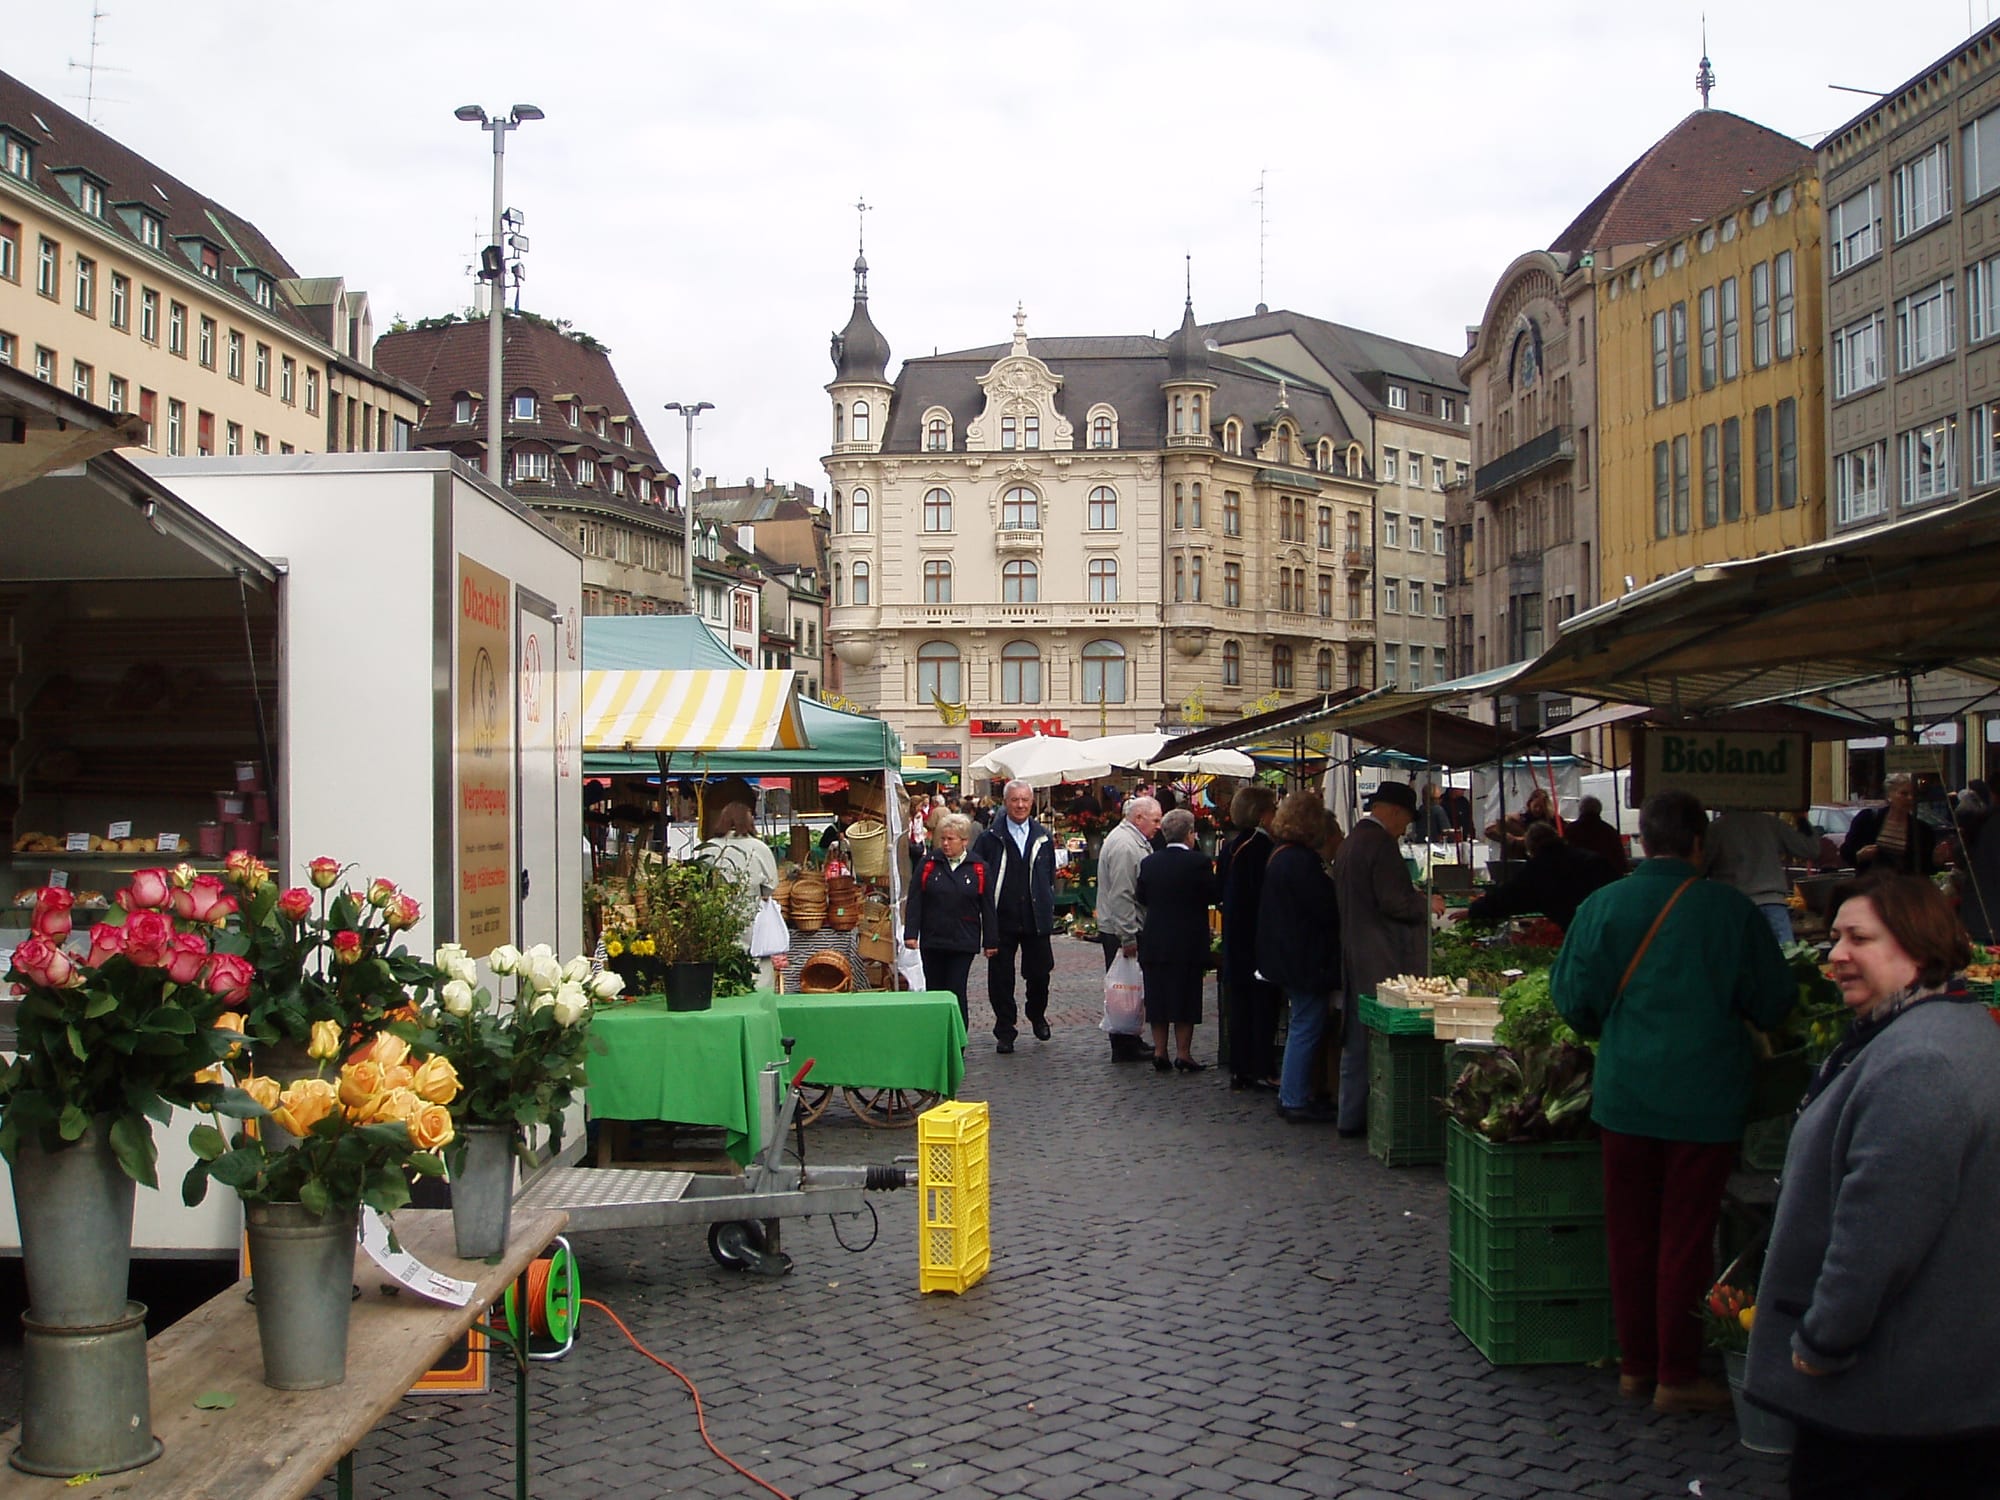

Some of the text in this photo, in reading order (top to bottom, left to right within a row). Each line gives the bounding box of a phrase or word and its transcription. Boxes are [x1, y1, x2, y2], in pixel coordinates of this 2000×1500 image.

[463, 576, 500, 630] Obacht
[1018, 719, 1069, 736] XXL
[1661, 736, 1787, 774] Bioland
[463, 782, 506, 816] Verpflegung
